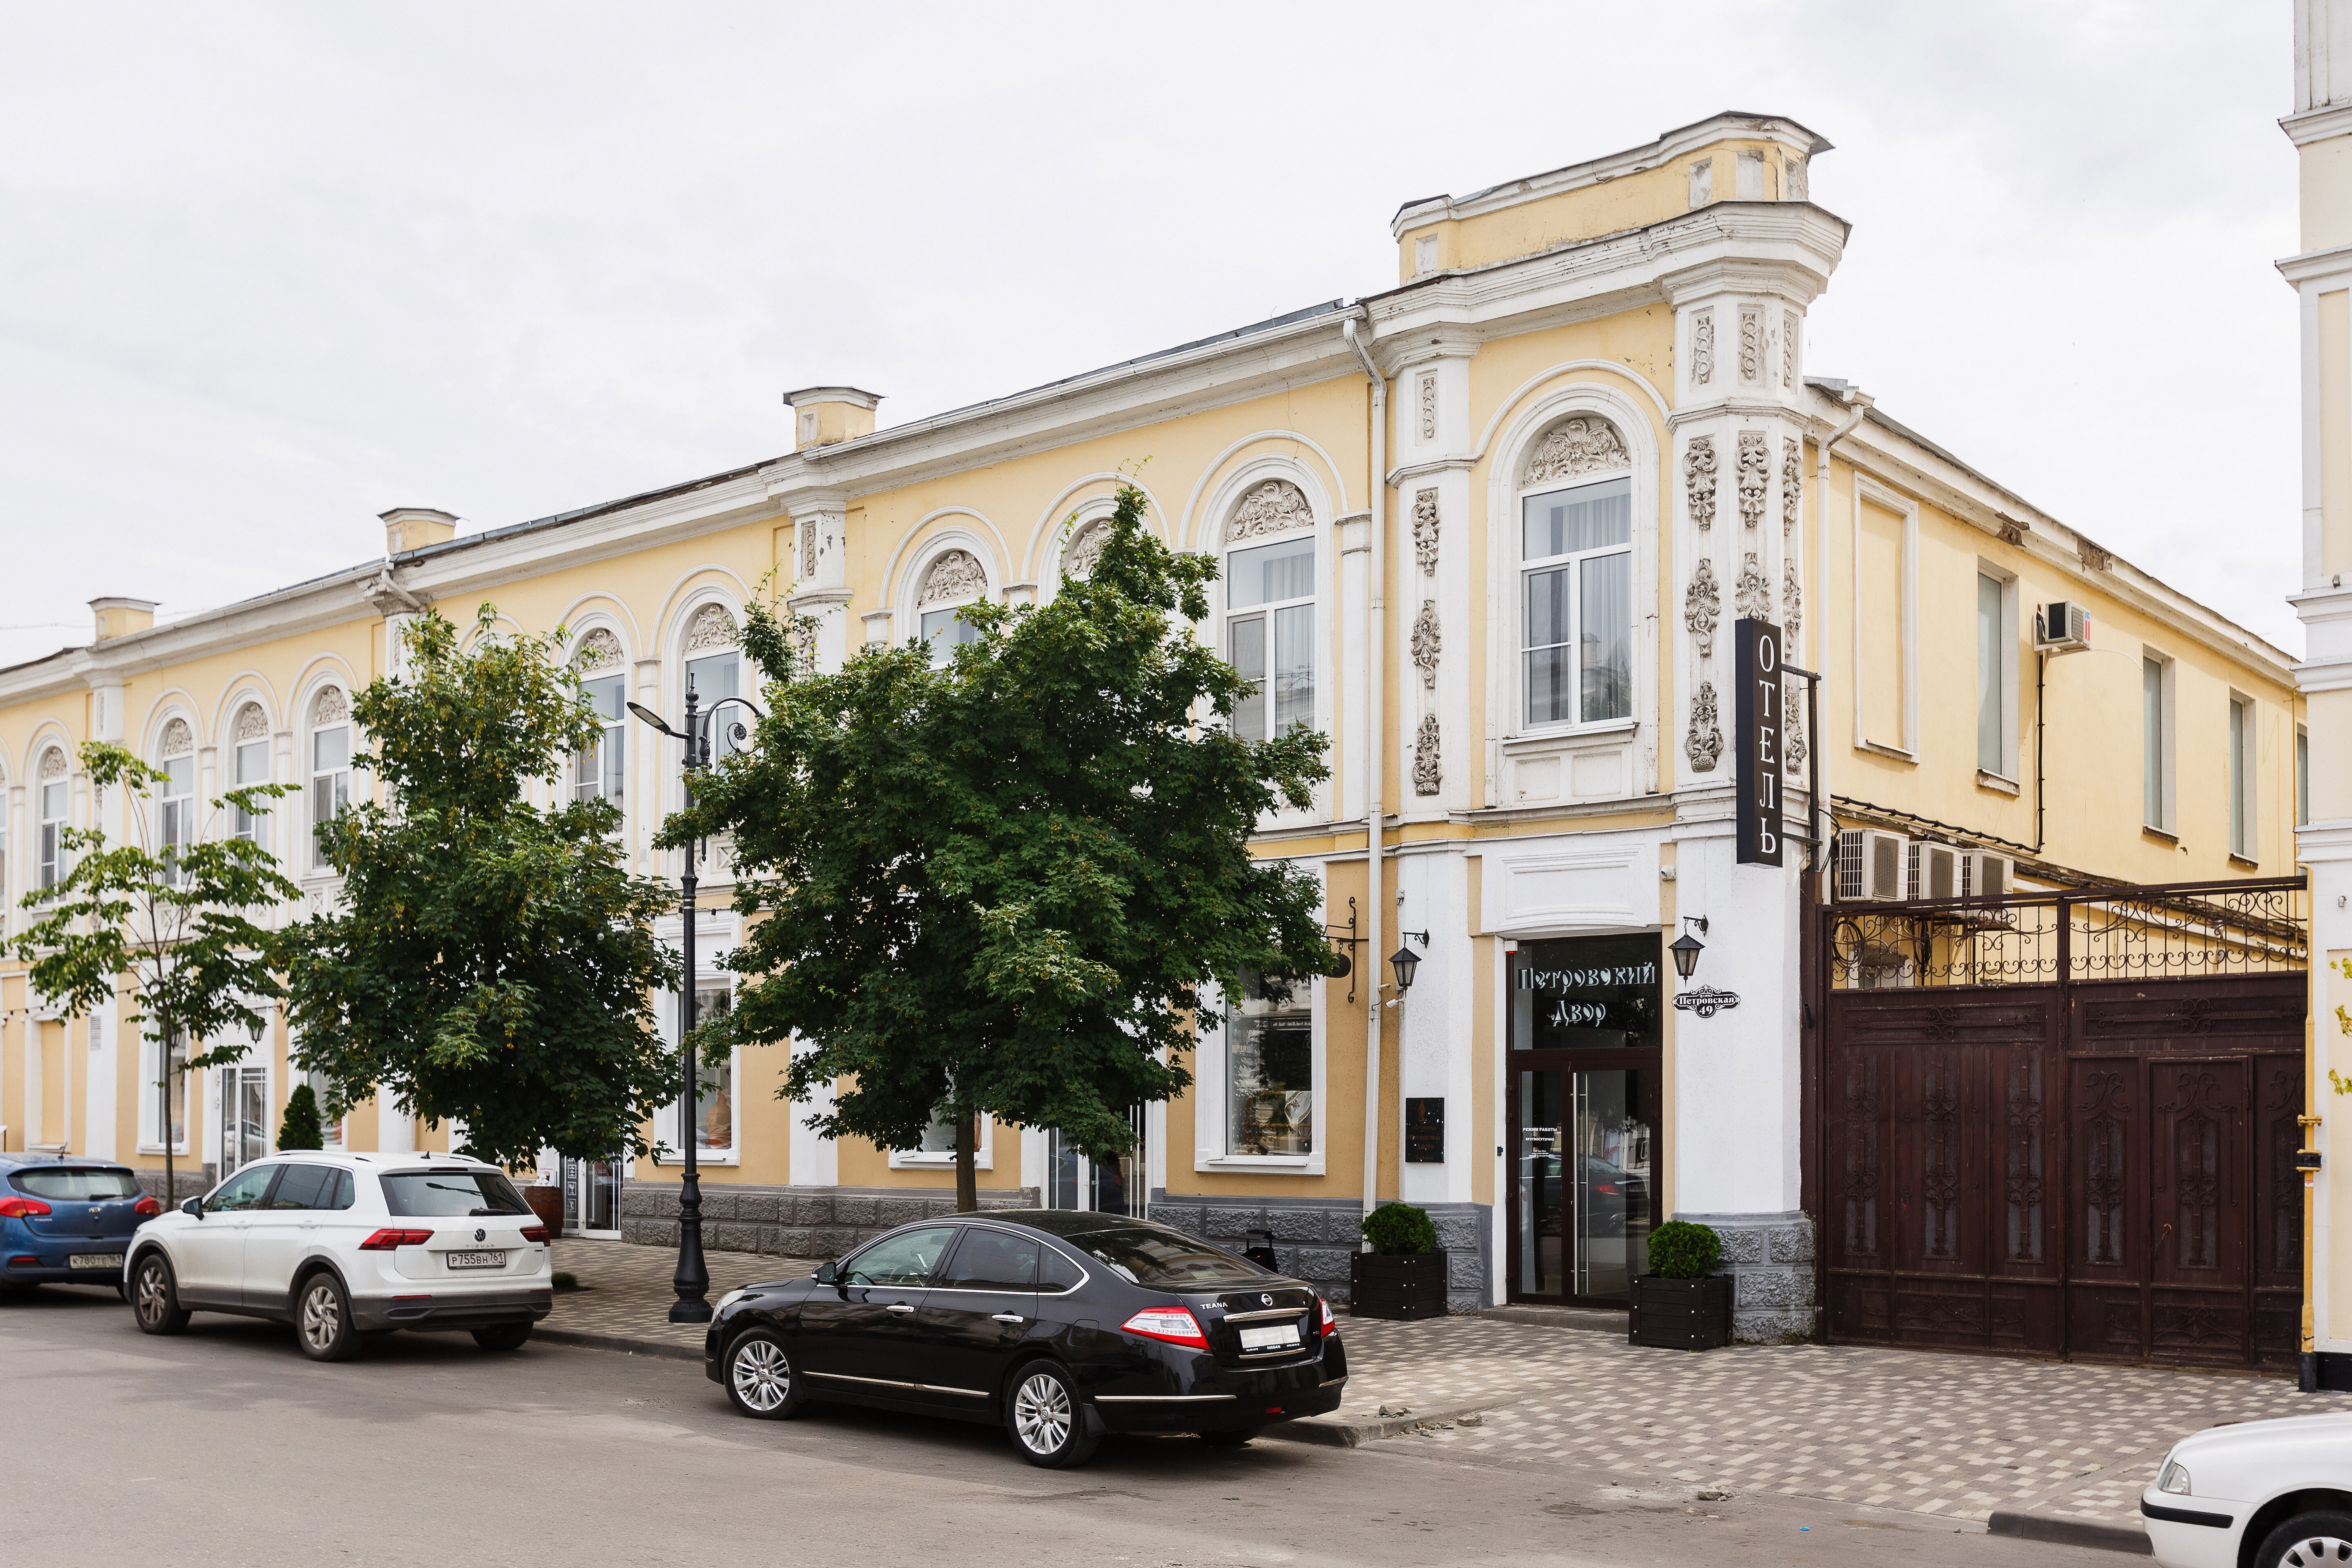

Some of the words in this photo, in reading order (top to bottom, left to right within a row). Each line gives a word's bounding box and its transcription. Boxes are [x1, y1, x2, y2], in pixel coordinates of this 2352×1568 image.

[1759, 635, 1776, 854] ОТЕЛЬ
[1518, 962, 1655, 994] Петровский
[1679, 997, 1734, 1006] Петровская
[1699, 1005, 1713, 1015] 49
[1552, 1000, 1606, 1027] Двор
[489, 1253, 502, 1261] 761
